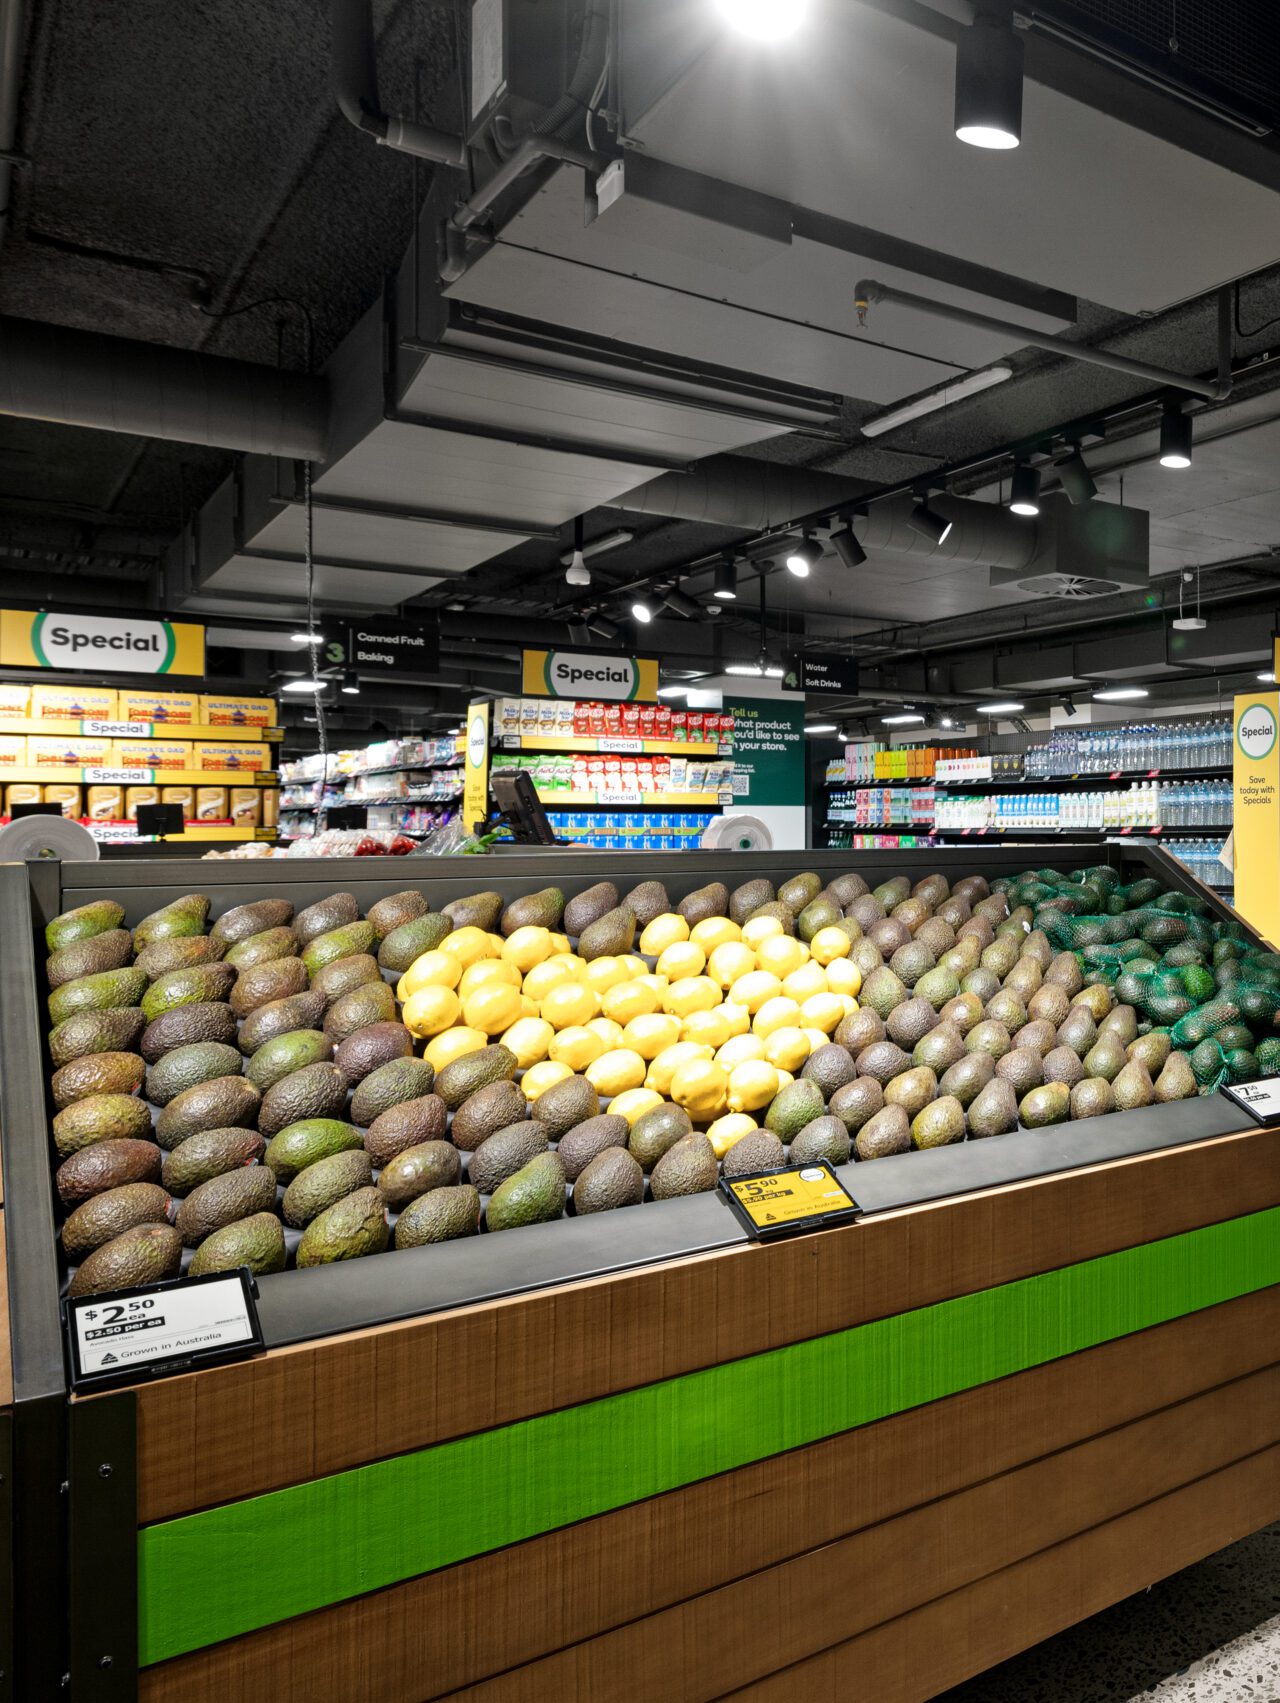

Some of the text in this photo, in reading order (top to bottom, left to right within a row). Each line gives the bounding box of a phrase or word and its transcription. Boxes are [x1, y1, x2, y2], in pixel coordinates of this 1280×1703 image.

[51, 627, 160, 651] Special
[357, 632, 425, 646] Canned Fruit
[326, 642, 345, 663] 3
[357, 651, 394, 664] Baking
[805, 663, 828, 672] Water
[556, 664, 629, 683] Special
[785, 672, 798, 688] 4
[805, 678, 842, 689] Soft Drinks
[208, 702, 249, 710] ULTIMATE
[729, 707, 758, 718] Tell us
[91, 722, 144, 734] Special
[755, 720, 791, 731] product
[734, 730, 754, 739] ou'd
[755, 730, 771, 739] like
[772, 732, 782, 740] to
[1241, 725, 1273, 739] Special
[603, 740, 638, 750] Special
[740, 742, 760, 752] your
[761, 742, 787, 751] store.
[92, 769, 145, 781] Special
[1249, 776, 1266, 784] Save
[1239, 785, 1275, 797] today with
[602, 793, 637, 802] Special
[1243, 795, 1272, 805] Specials
[128, 1313, 147, 1321] ea
[86, 1318, 162, 1340] $2.50 per ea
[120, 1332, 222, 1359] Grown in Australia
